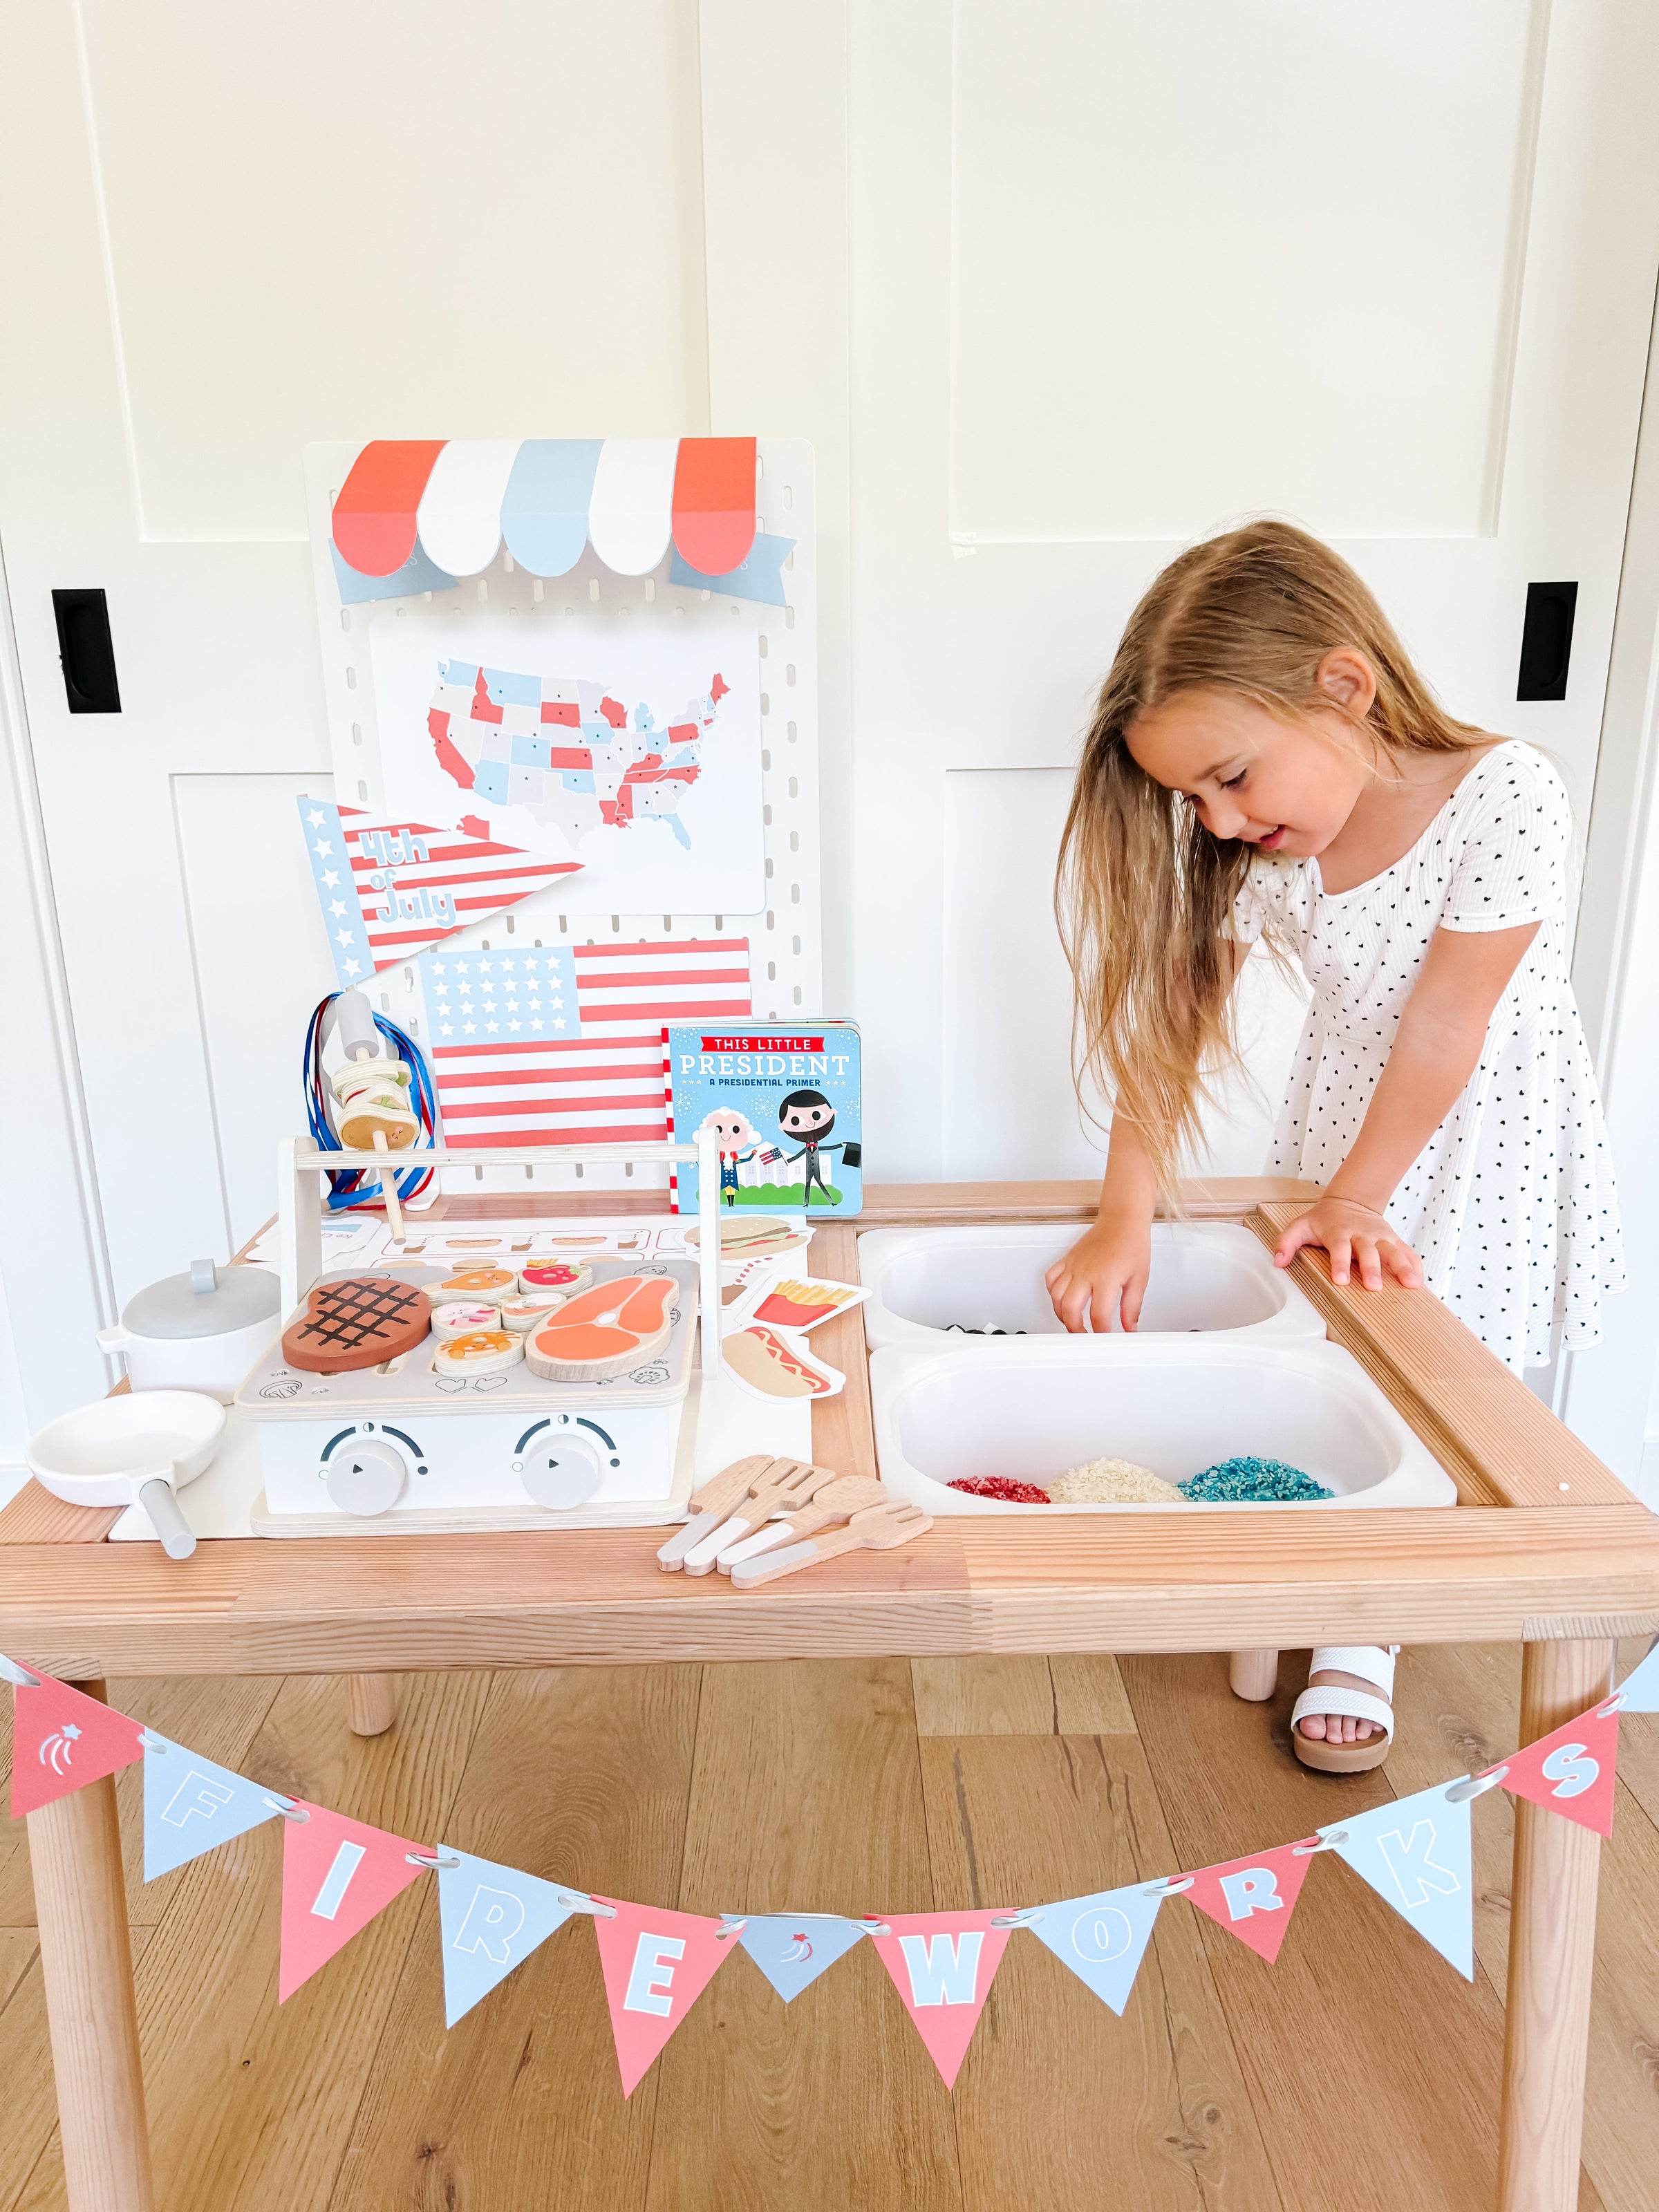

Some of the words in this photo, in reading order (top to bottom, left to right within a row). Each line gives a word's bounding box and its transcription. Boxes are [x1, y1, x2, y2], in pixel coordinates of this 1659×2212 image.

[358, 829, 430, 866] 4th
[370, 868, 397, 890] of
[376, 888, 456, 929] July
[714, 1038, 749, 1050] THIS
[758, 1039, 812, 1051] LITTLE
[679, 1054, 850, 1076] PRESIDENT
[719, 1078, 782, 1087] PRESIDENTIAL
[786, 1078, 821, 1087] PRIMER
